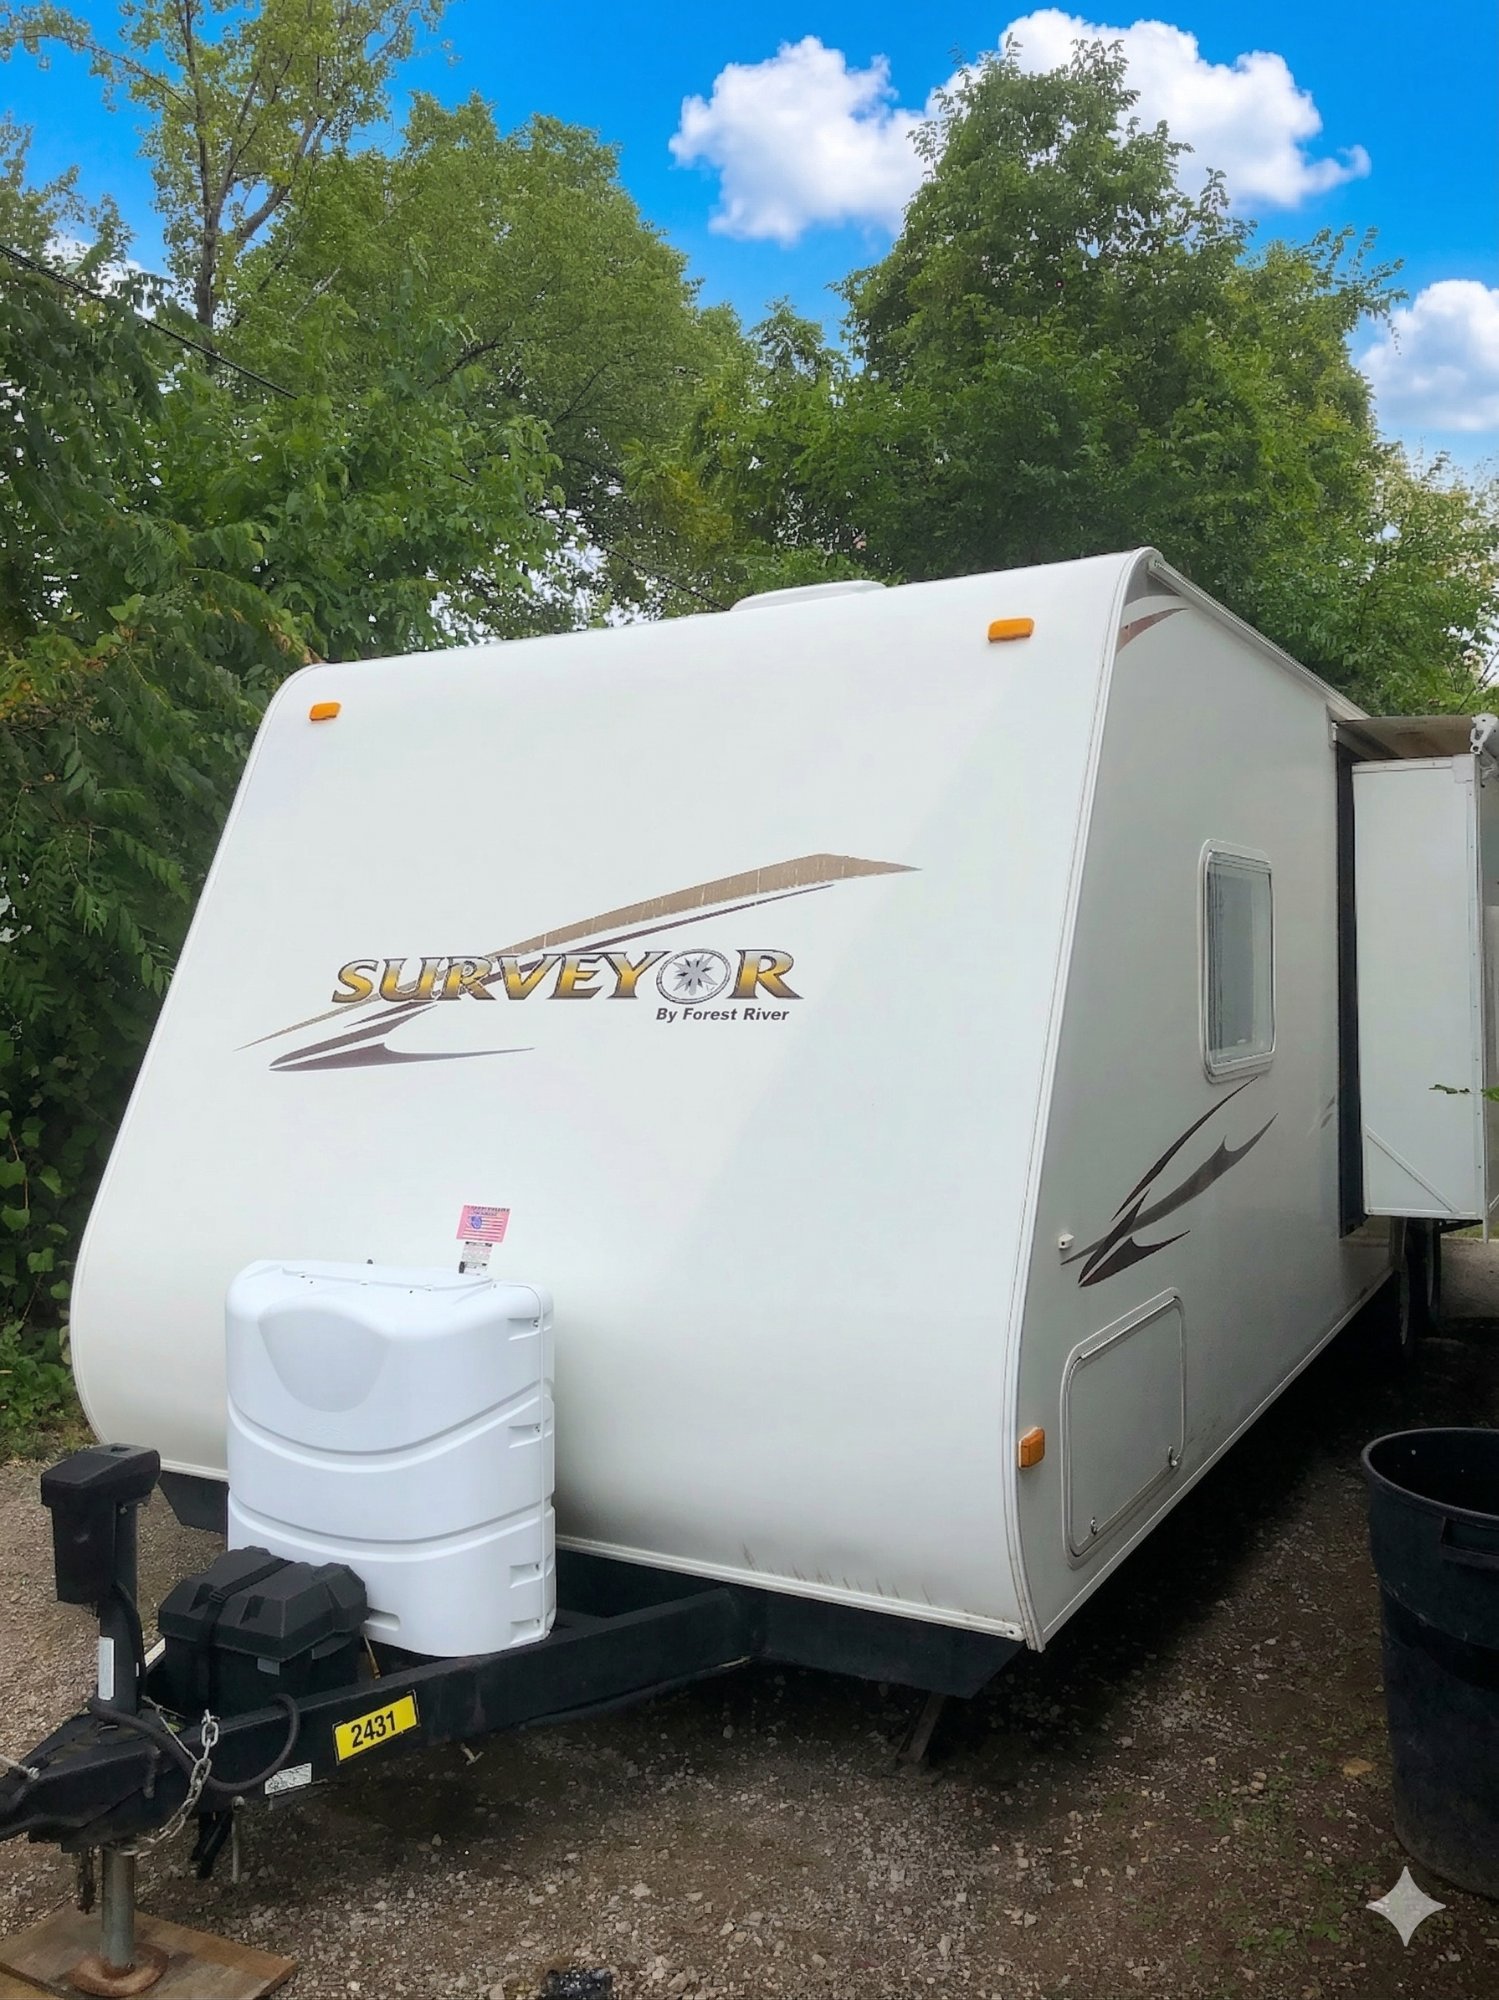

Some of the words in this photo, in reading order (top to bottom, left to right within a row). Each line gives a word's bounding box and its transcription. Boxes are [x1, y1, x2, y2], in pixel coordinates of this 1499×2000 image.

[331, 948, 804, 1005] SURVEYOR
[656, 1007, 678, 1023] By
[682, 1007, 738, 1021] Forest
[743, 1007, 790, 1021] River
[351, 1710, 396, 1748] 2431
